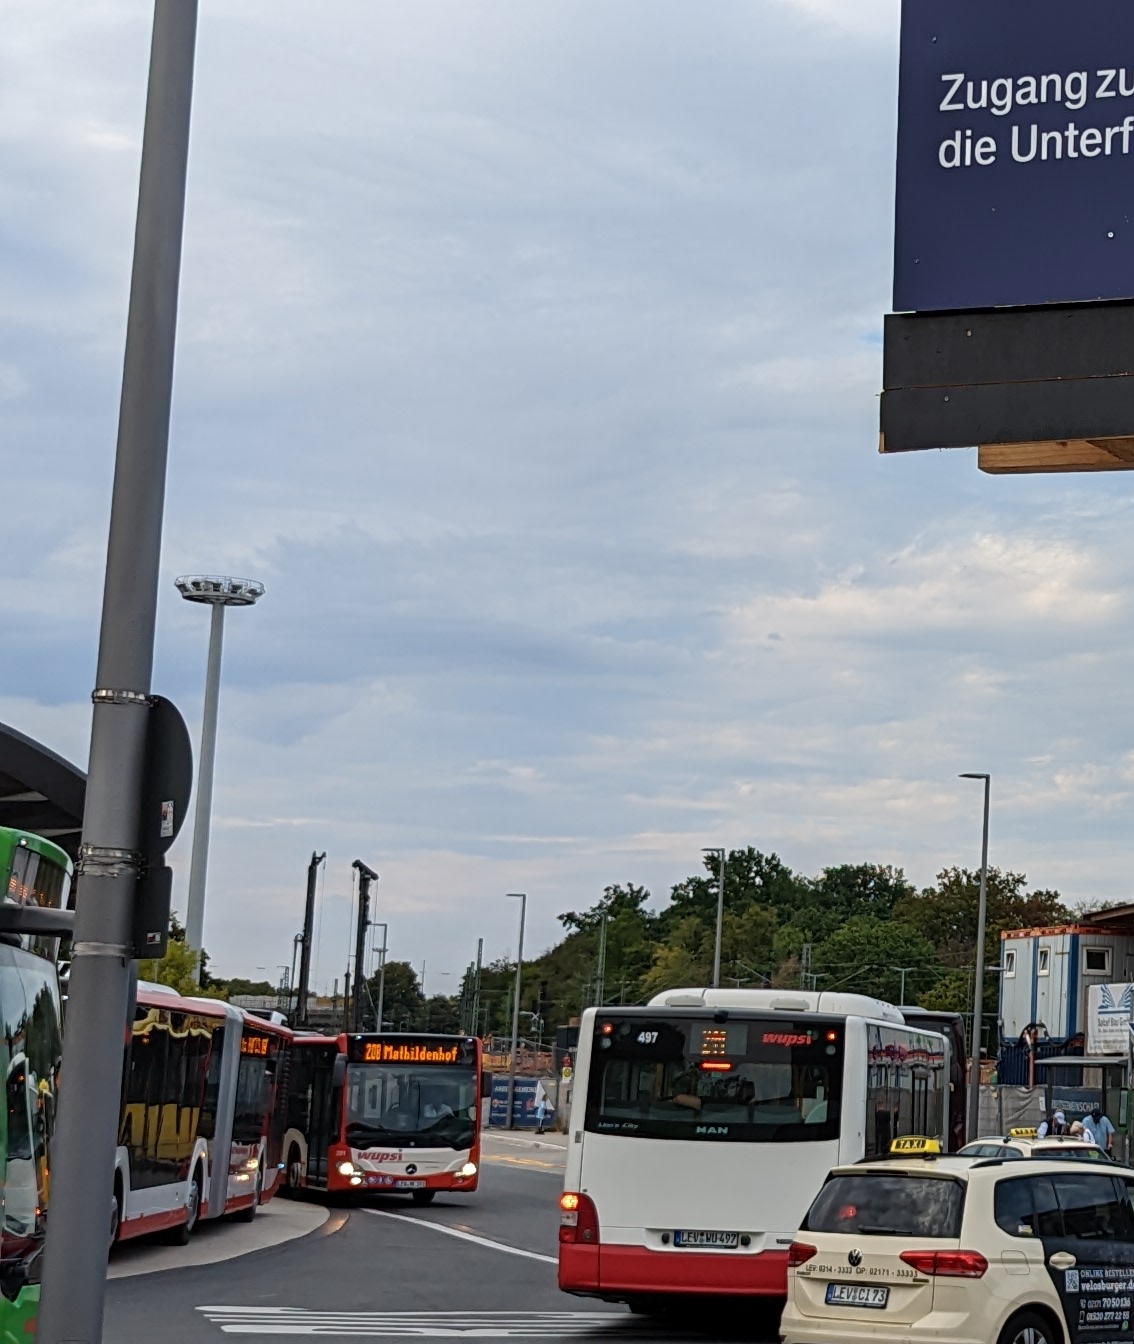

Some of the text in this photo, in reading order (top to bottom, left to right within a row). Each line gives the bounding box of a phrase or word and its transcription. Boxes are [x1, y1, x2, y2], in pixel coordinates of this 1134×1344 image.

[938, 71, 1088, 115] Zugang
[938, 130, 997, 169] die
[637, 1031, 659, 1044] 497
[762, 1030, 812, 1047] wupsi
[383, 1044, 458, 1062] Mathildenhof
[696, 1126, 729, 1134] MAN
[899, 1139, 923, 1149] TAXI
[357, 1148, 403, 1163] wupsi
[681, 1231, 737, 1244] LEV WU 497
[805, 1263, 818, 1273] LEV:
[818, 1265, 833, 1273] 0214
[837, 1266, 853, 1274] 3333
[869, 1267, 890, 1277] 02171
[896, 1269, 918, 1278] 33333
[1080, 1269, 1104, 1278] ONLINE
[832, 1284, 886, 1302] LEV CI 73
